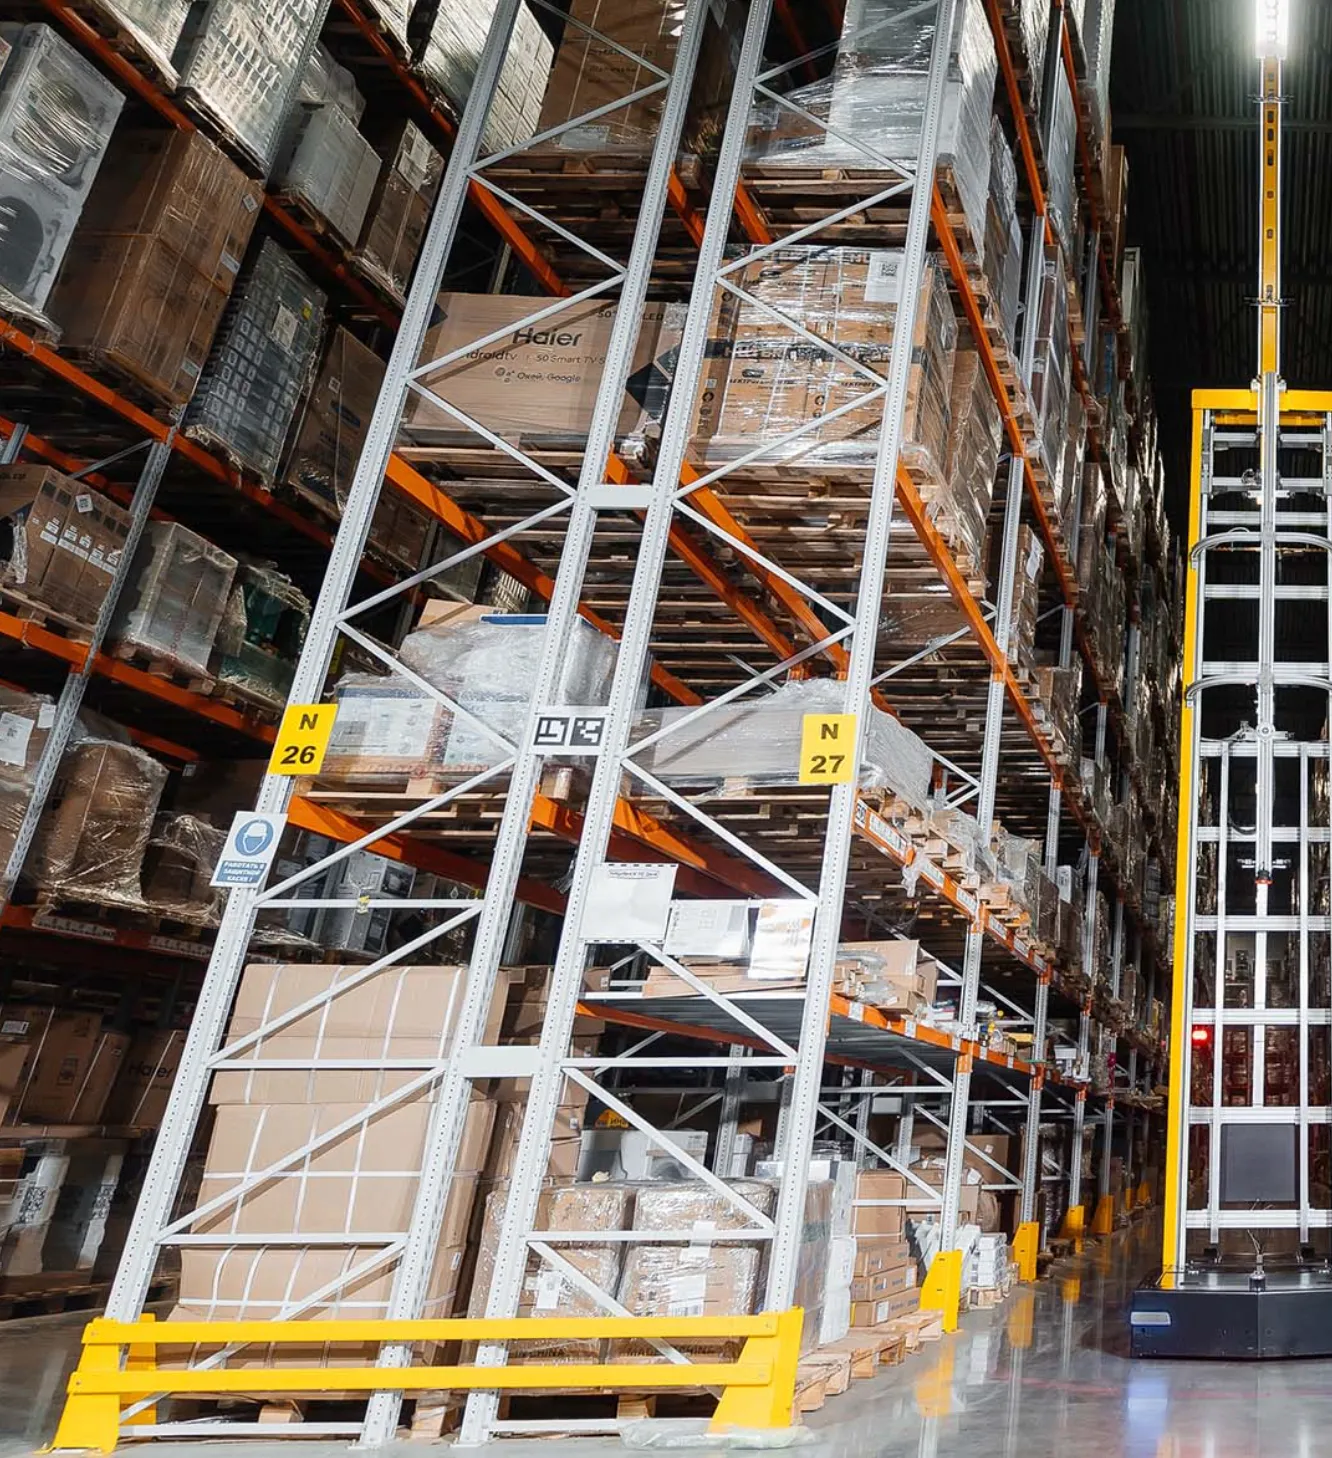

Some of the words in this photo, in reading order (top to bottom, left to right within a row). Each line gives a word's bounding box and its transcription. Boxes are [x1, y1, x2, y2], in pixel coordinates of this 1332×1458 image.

[512, 328, 582, 347] Haier
[547, 373, 581, 384] Google
[298, 713, 318, 730] N
[821, 723, 839, 740] N
[280, 745, 317, 765] 26
[809, 755, 846, 774] 27
